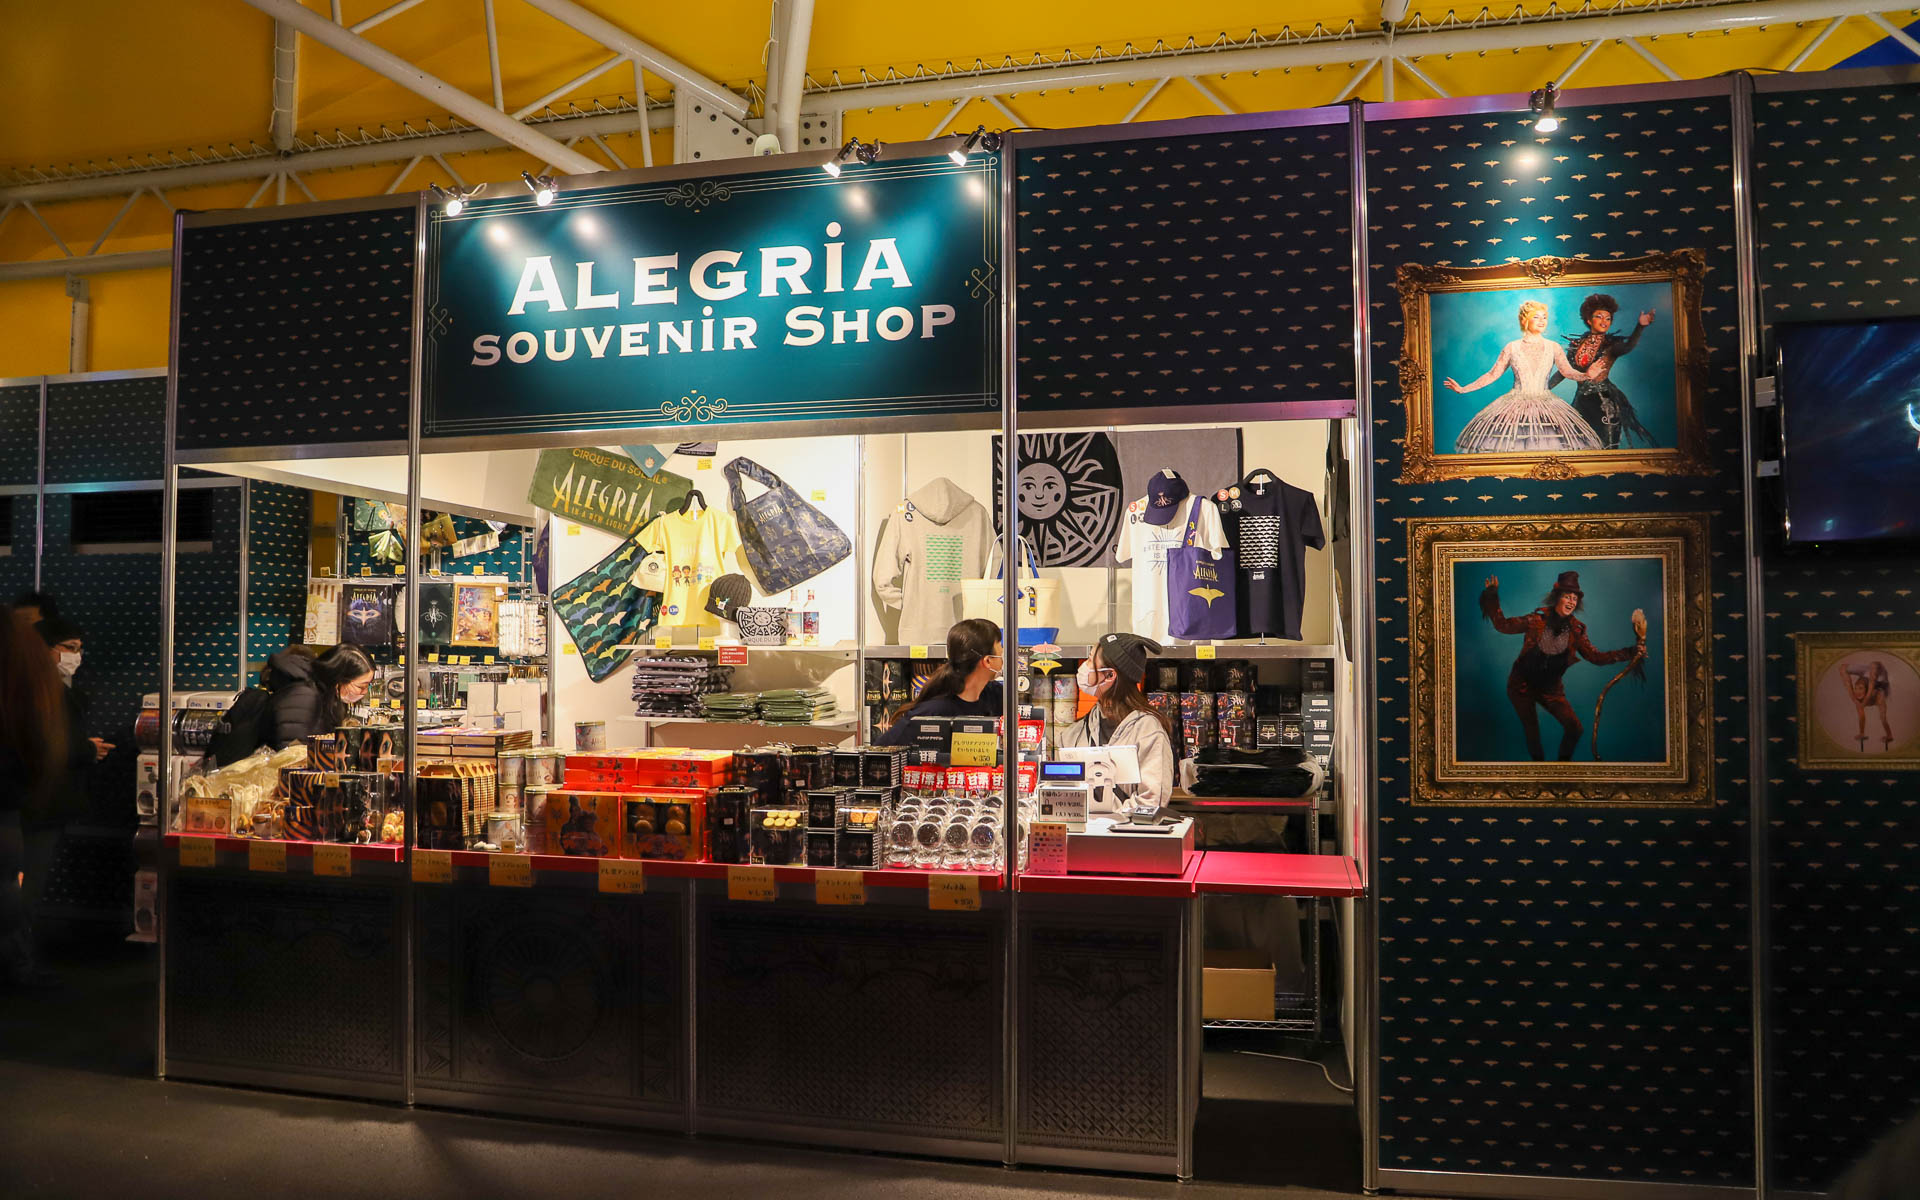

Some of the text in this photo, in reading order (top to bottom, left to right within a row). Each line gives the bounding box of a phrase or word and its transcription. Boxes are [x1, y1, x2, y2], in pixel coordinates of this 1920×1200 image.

[783, 304, 956, 346] SHOP
[572, 447, 611, 467] CIRQUE
[611, 459, 627, 471] DU
[571, 507, 579, 515] IN
[968, 772, 989, 788] 甘栗
